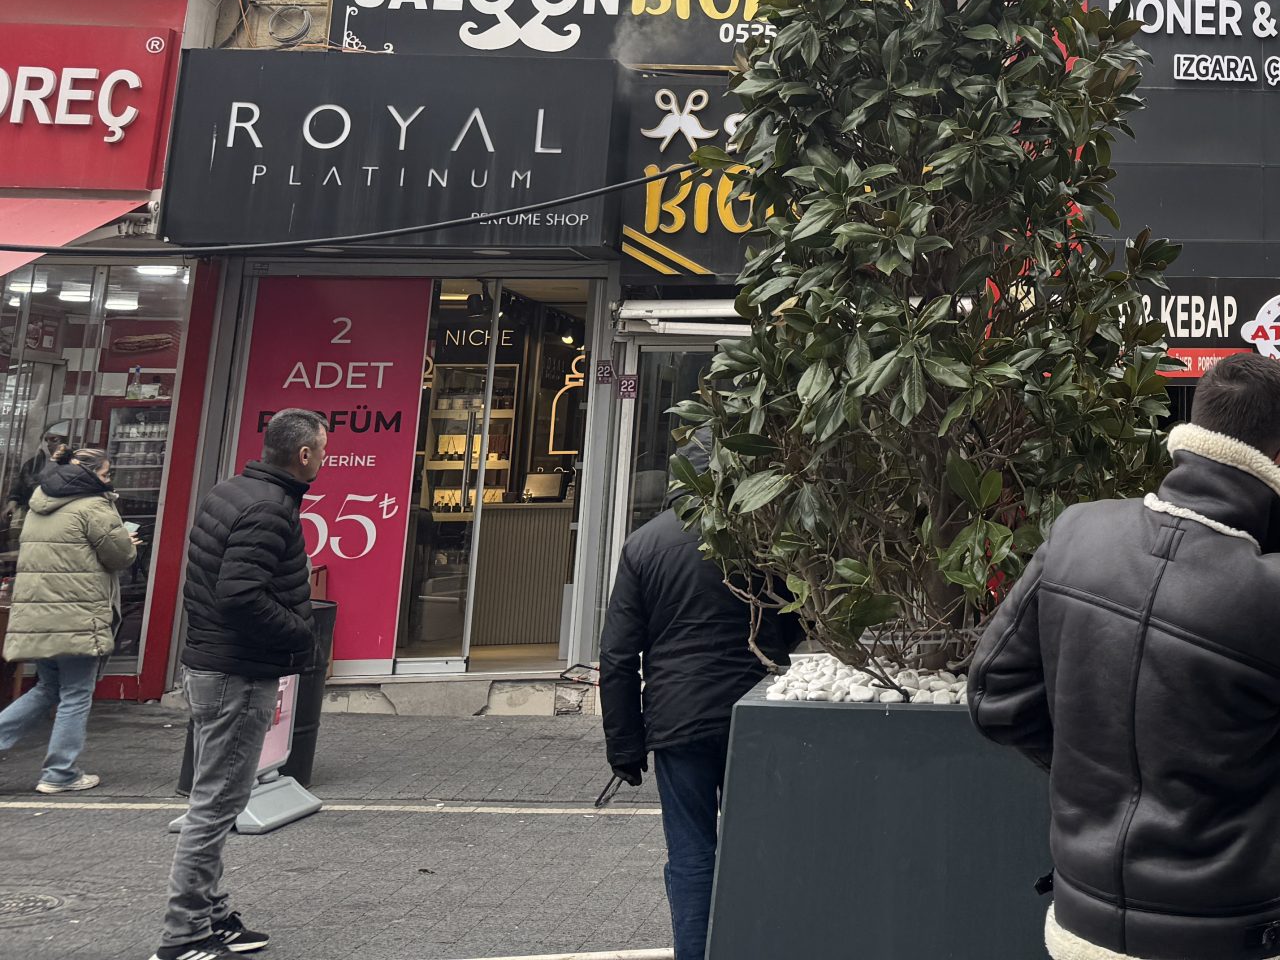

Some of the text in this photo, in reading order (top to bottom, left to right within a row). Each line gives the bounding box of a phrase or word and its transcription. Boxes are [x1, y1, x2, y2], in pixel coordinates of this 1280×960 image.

[1252, 1, 1278, 38] &
[1174, 54, 1257, 83] IZGARA
[0, 66, 142, 143] REÇ
[226, 102, 562, 153] ROYAL
[252, 165, 531, 189] PLATINUM
[546, 214, 589, 226] SHOP
[1161, 295, 1237, 338] KEBAP
[330, 317, 352, 344] 2
[445, 329, 515, 346] NICHE
[282, 361, 393, 389] ADET
[597, 366, 611, 377] 22
[621, 380, 635, 392] 22
[257, 405, 401, 433] PFÜM
[320, 452, 376, 467] YERİNE
